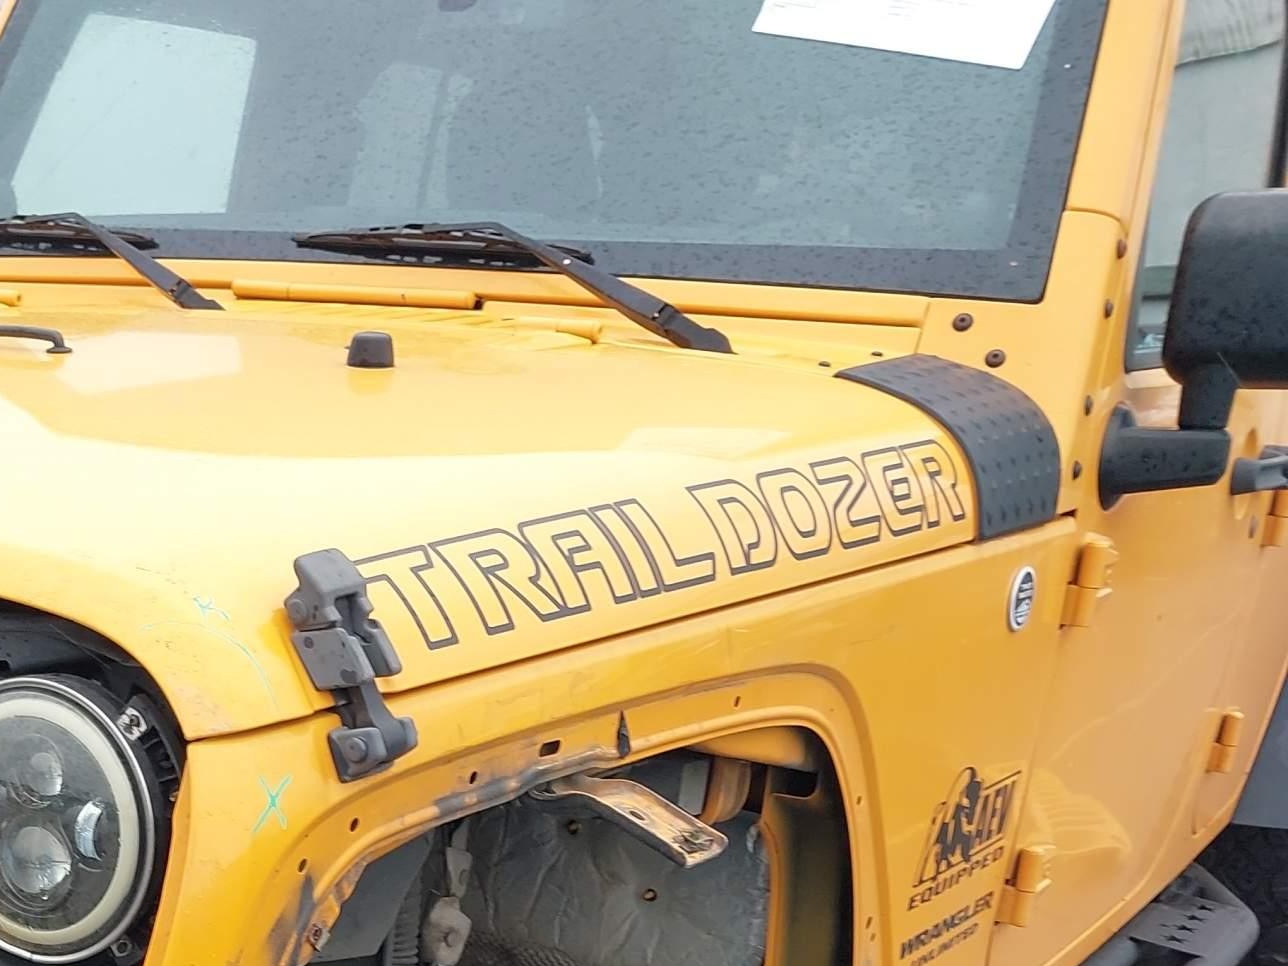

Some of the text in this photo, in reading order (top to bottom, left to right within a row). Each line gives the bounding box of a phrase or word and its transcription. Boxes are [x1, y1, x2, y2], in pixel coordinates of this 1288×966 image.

[356, 438, 966, 651] TRAIL DOZER
[907, 845, 1004, 911] EQUIPPED
[900, 890, 994, 960] WRANGLER
